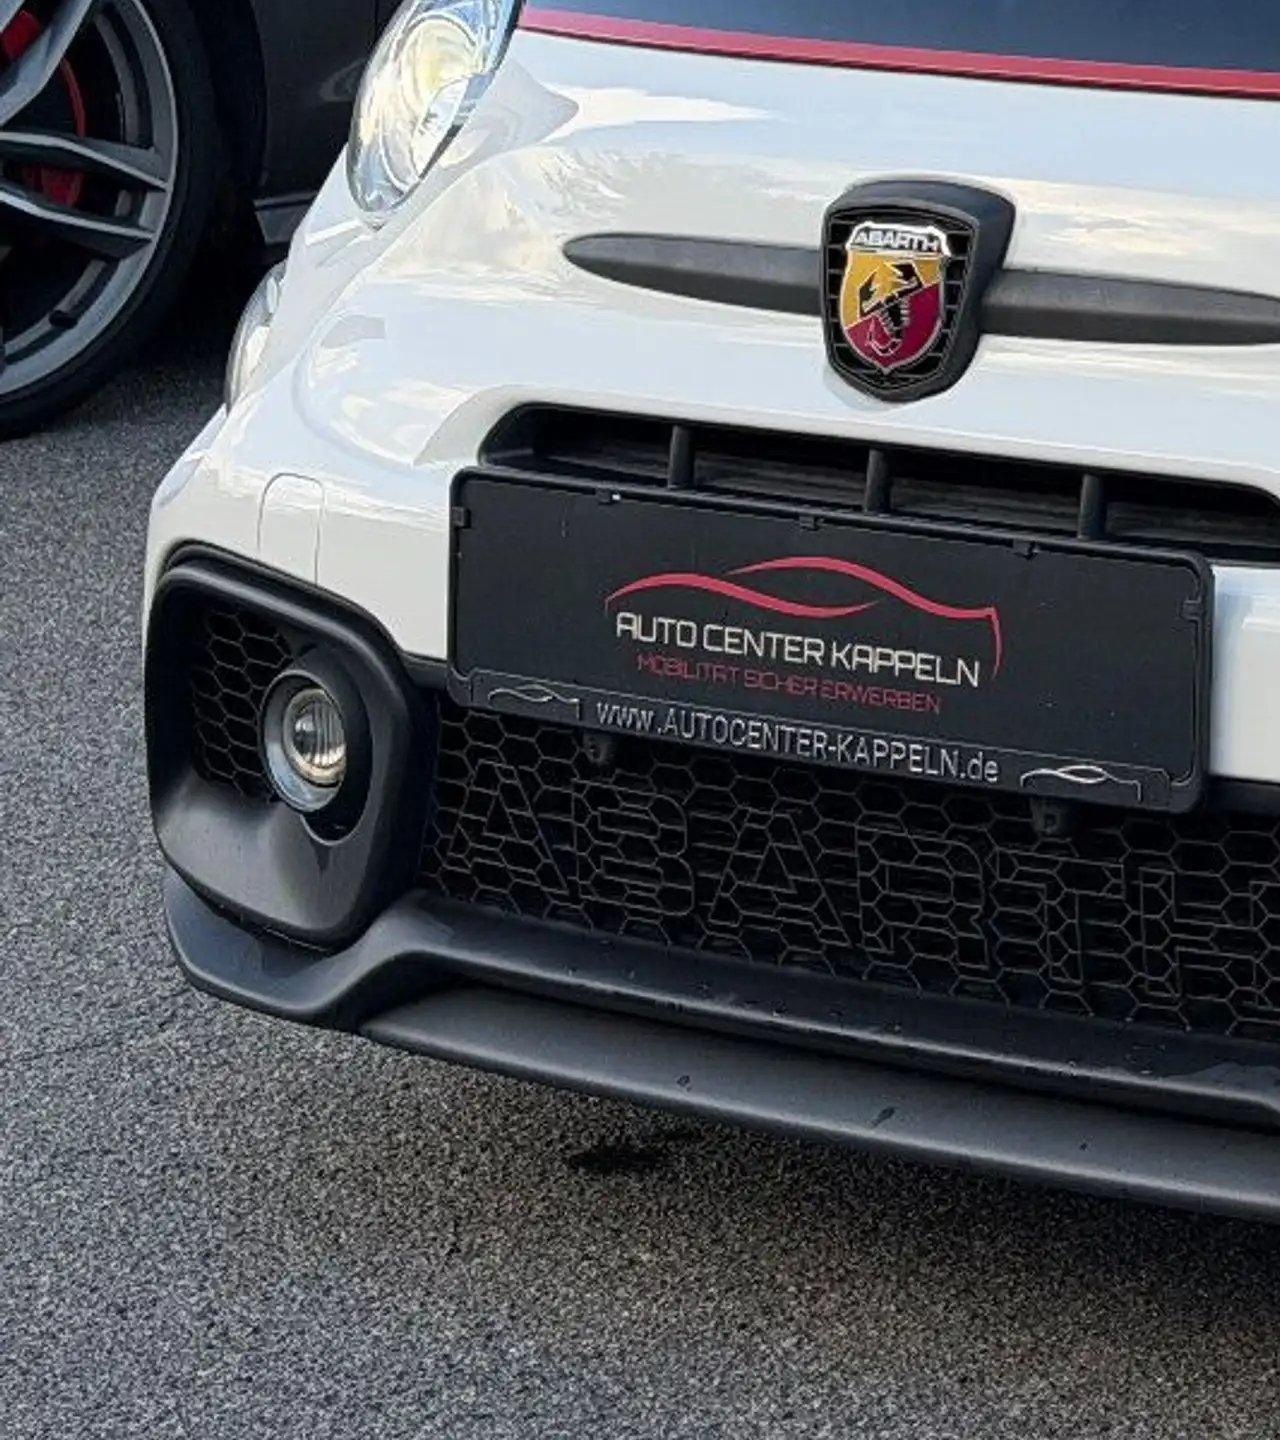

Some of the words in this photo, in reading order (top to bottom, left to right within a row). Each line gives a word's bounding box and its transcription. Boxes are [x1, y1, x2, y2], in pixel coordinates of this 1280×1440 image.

[855, 229, 939, 253] ABARTH
[616, 611, 697, 649] AUTO
[703, 626, 824, 667] CENTER
[831, 641, 981, 688] KAPPELN
[821, 679, 941, 715] ERWERBEN
